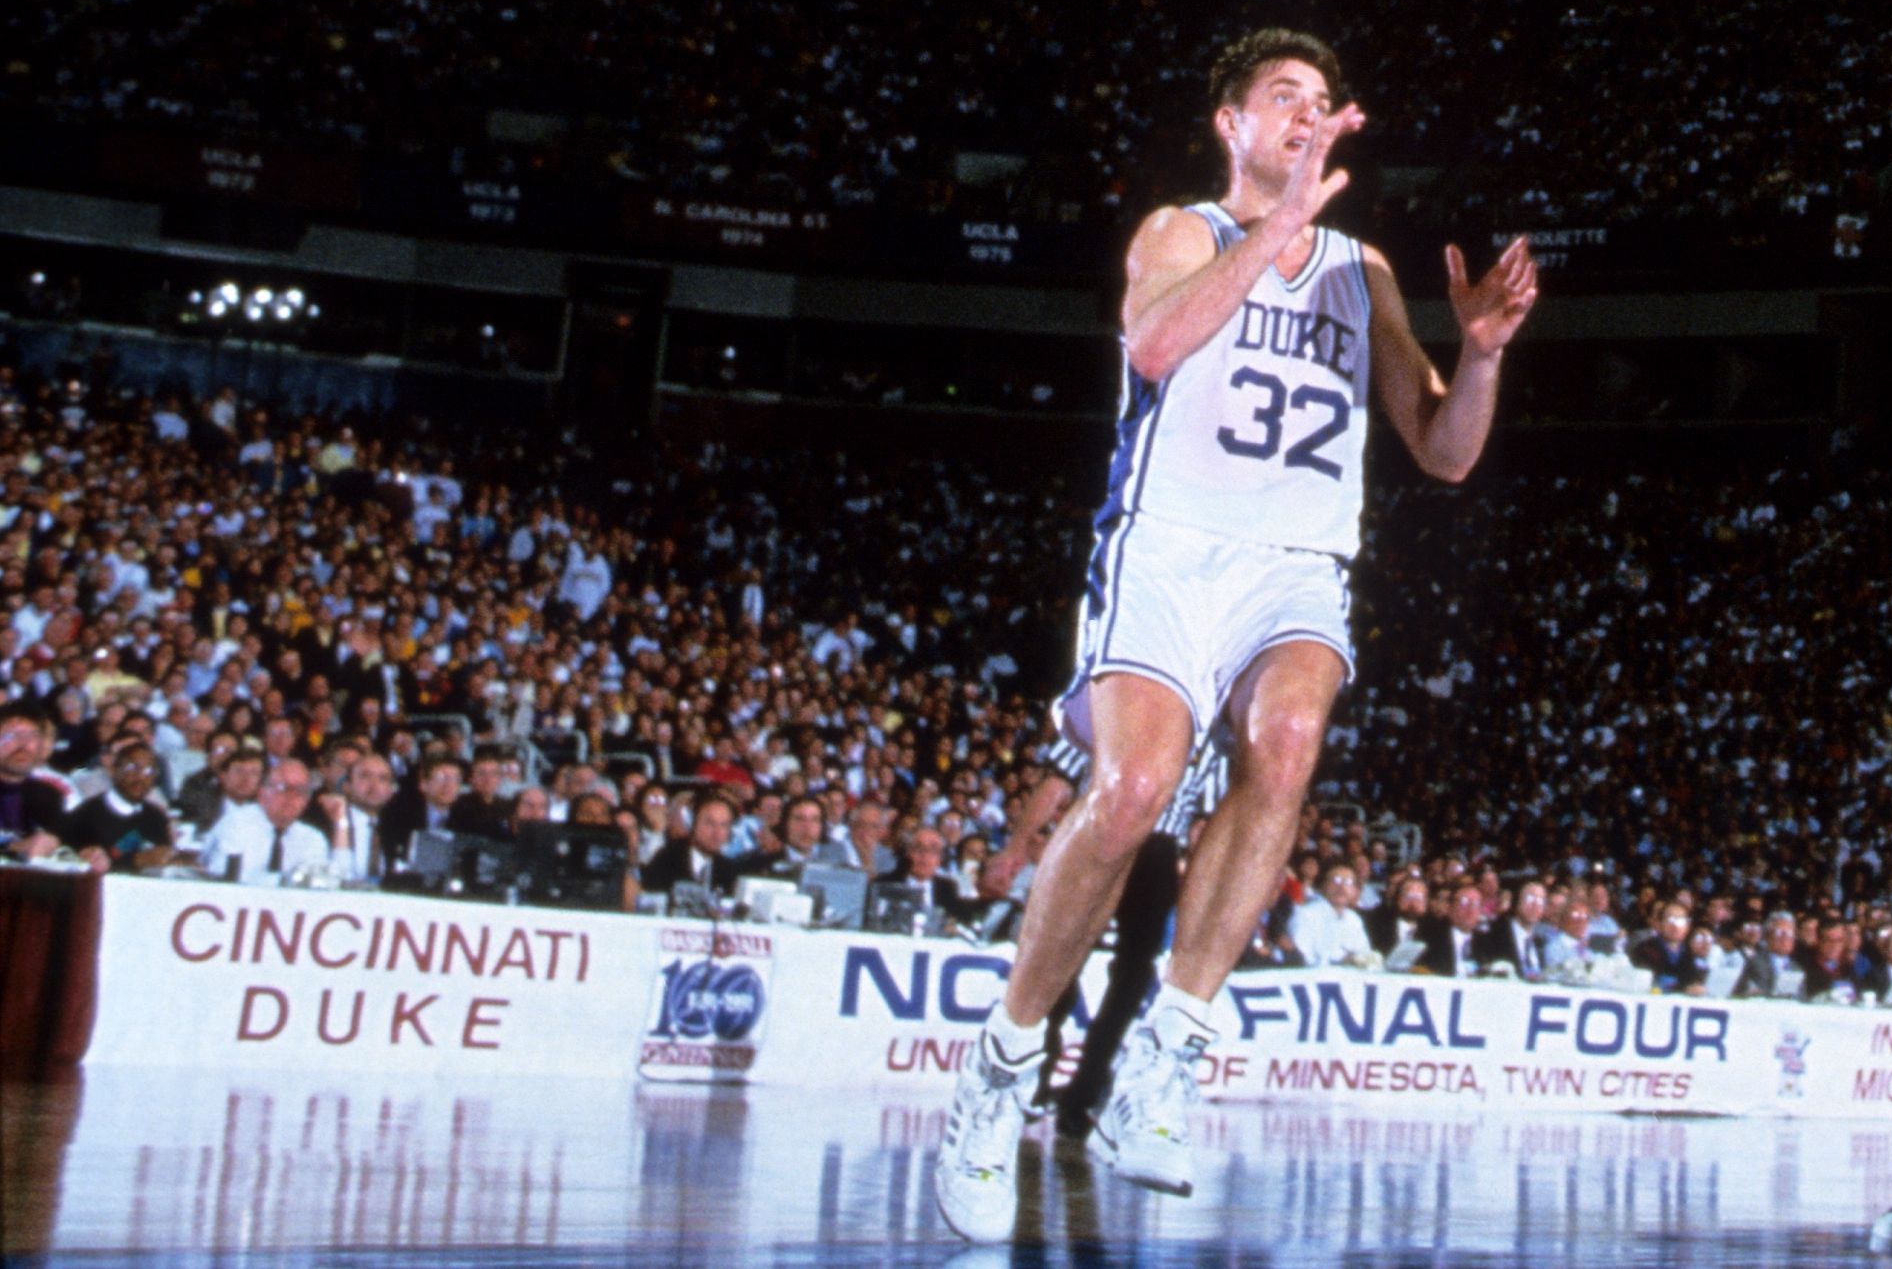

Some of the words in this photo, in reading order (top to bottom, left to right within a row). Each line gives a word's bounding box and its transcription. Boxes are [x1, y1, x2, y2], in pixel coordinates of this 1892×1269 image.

[1491, 228, 1608, 248] MQUETTE
[1234, 300, 1355, 382] DUKE
[1217, 366, 1350, 482] 32
[171, 903, 590, 983] CINCINNATI
[235, 985, 510, 1050] DUKE
[1227, 982, 1488, 1048] FINAL
[1525, 995, 1730, 1062] FOUR
[1265, 1058, 1486, 1100] MINNESOTA,
[1502, 1064, 1585, 1097] TWIN
[1598, 1068, 1692, 1099] CITIES
